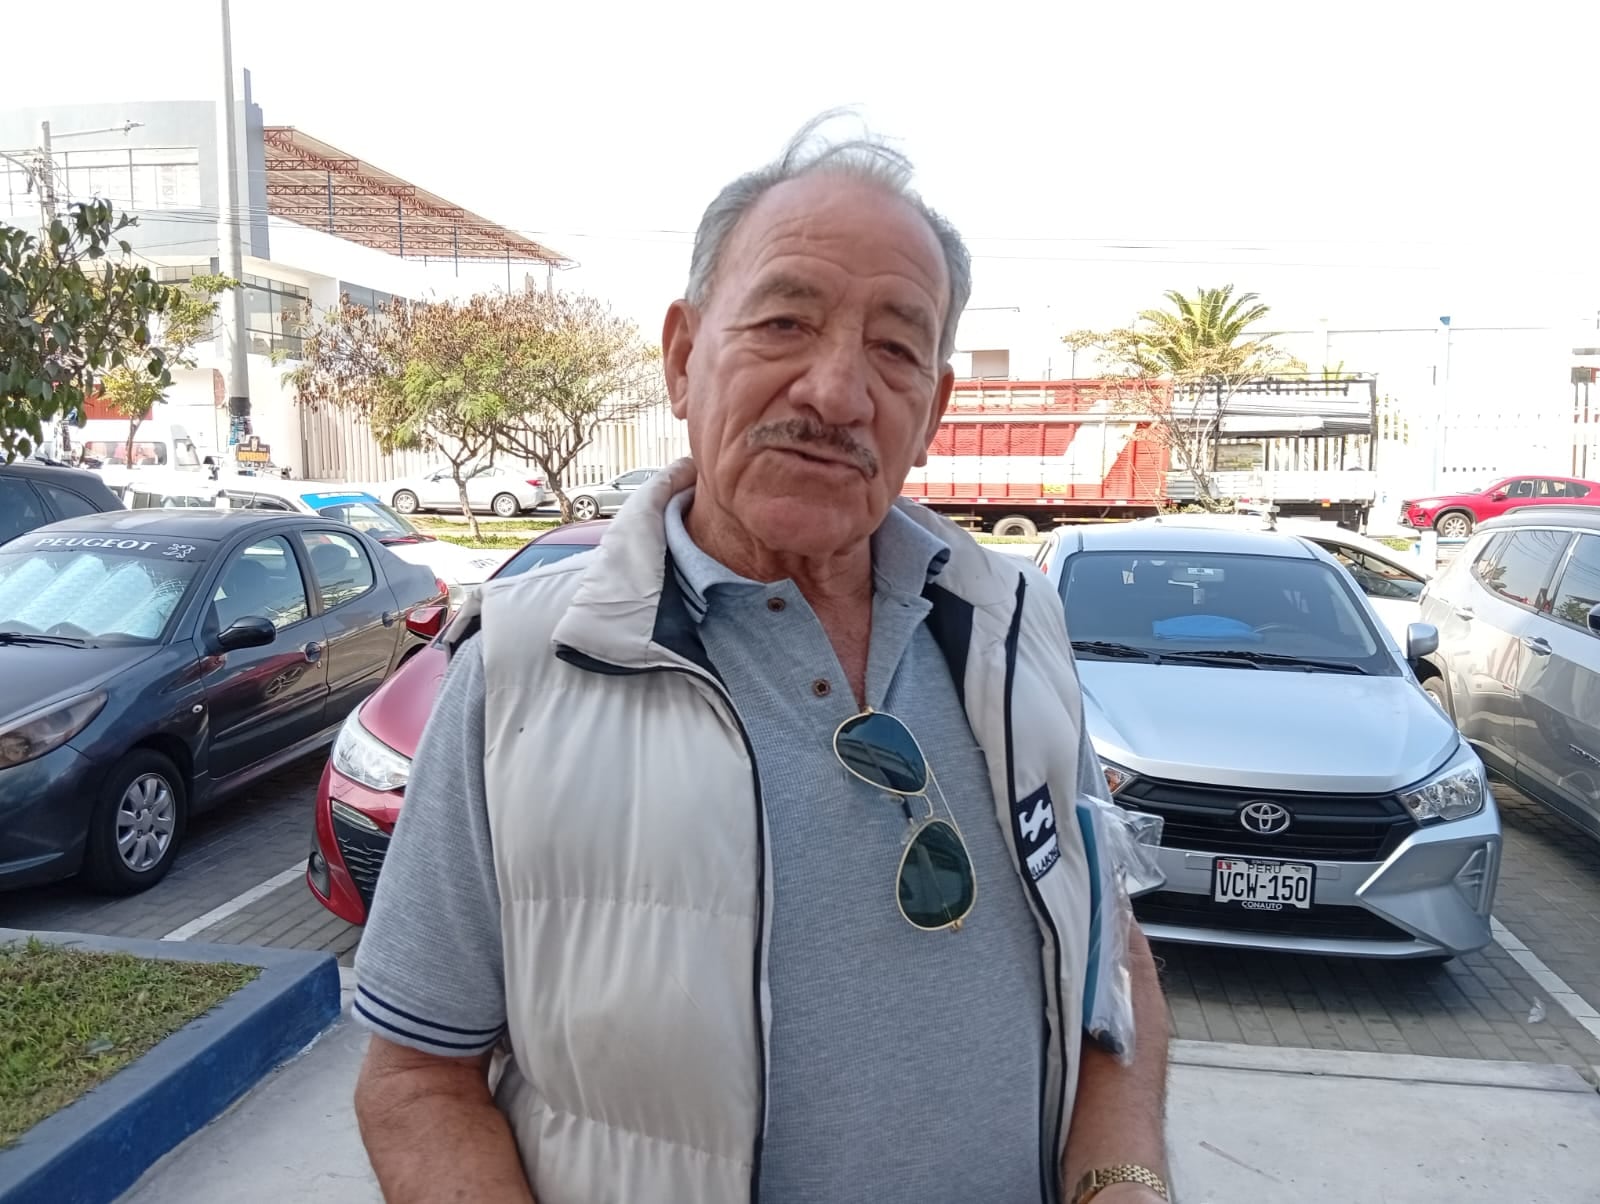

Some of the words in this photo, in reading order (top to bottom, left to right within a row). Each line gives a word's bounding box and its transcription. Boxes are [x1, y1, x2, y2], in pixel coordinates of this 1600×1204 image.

[34, 537, 158, 551] PEUGEOT
[1247, 863, 1282, 875] PERU
[1219, 870, 1308, 902] VCW-150
[1241, 900, 1283, 911] CONAUTO
